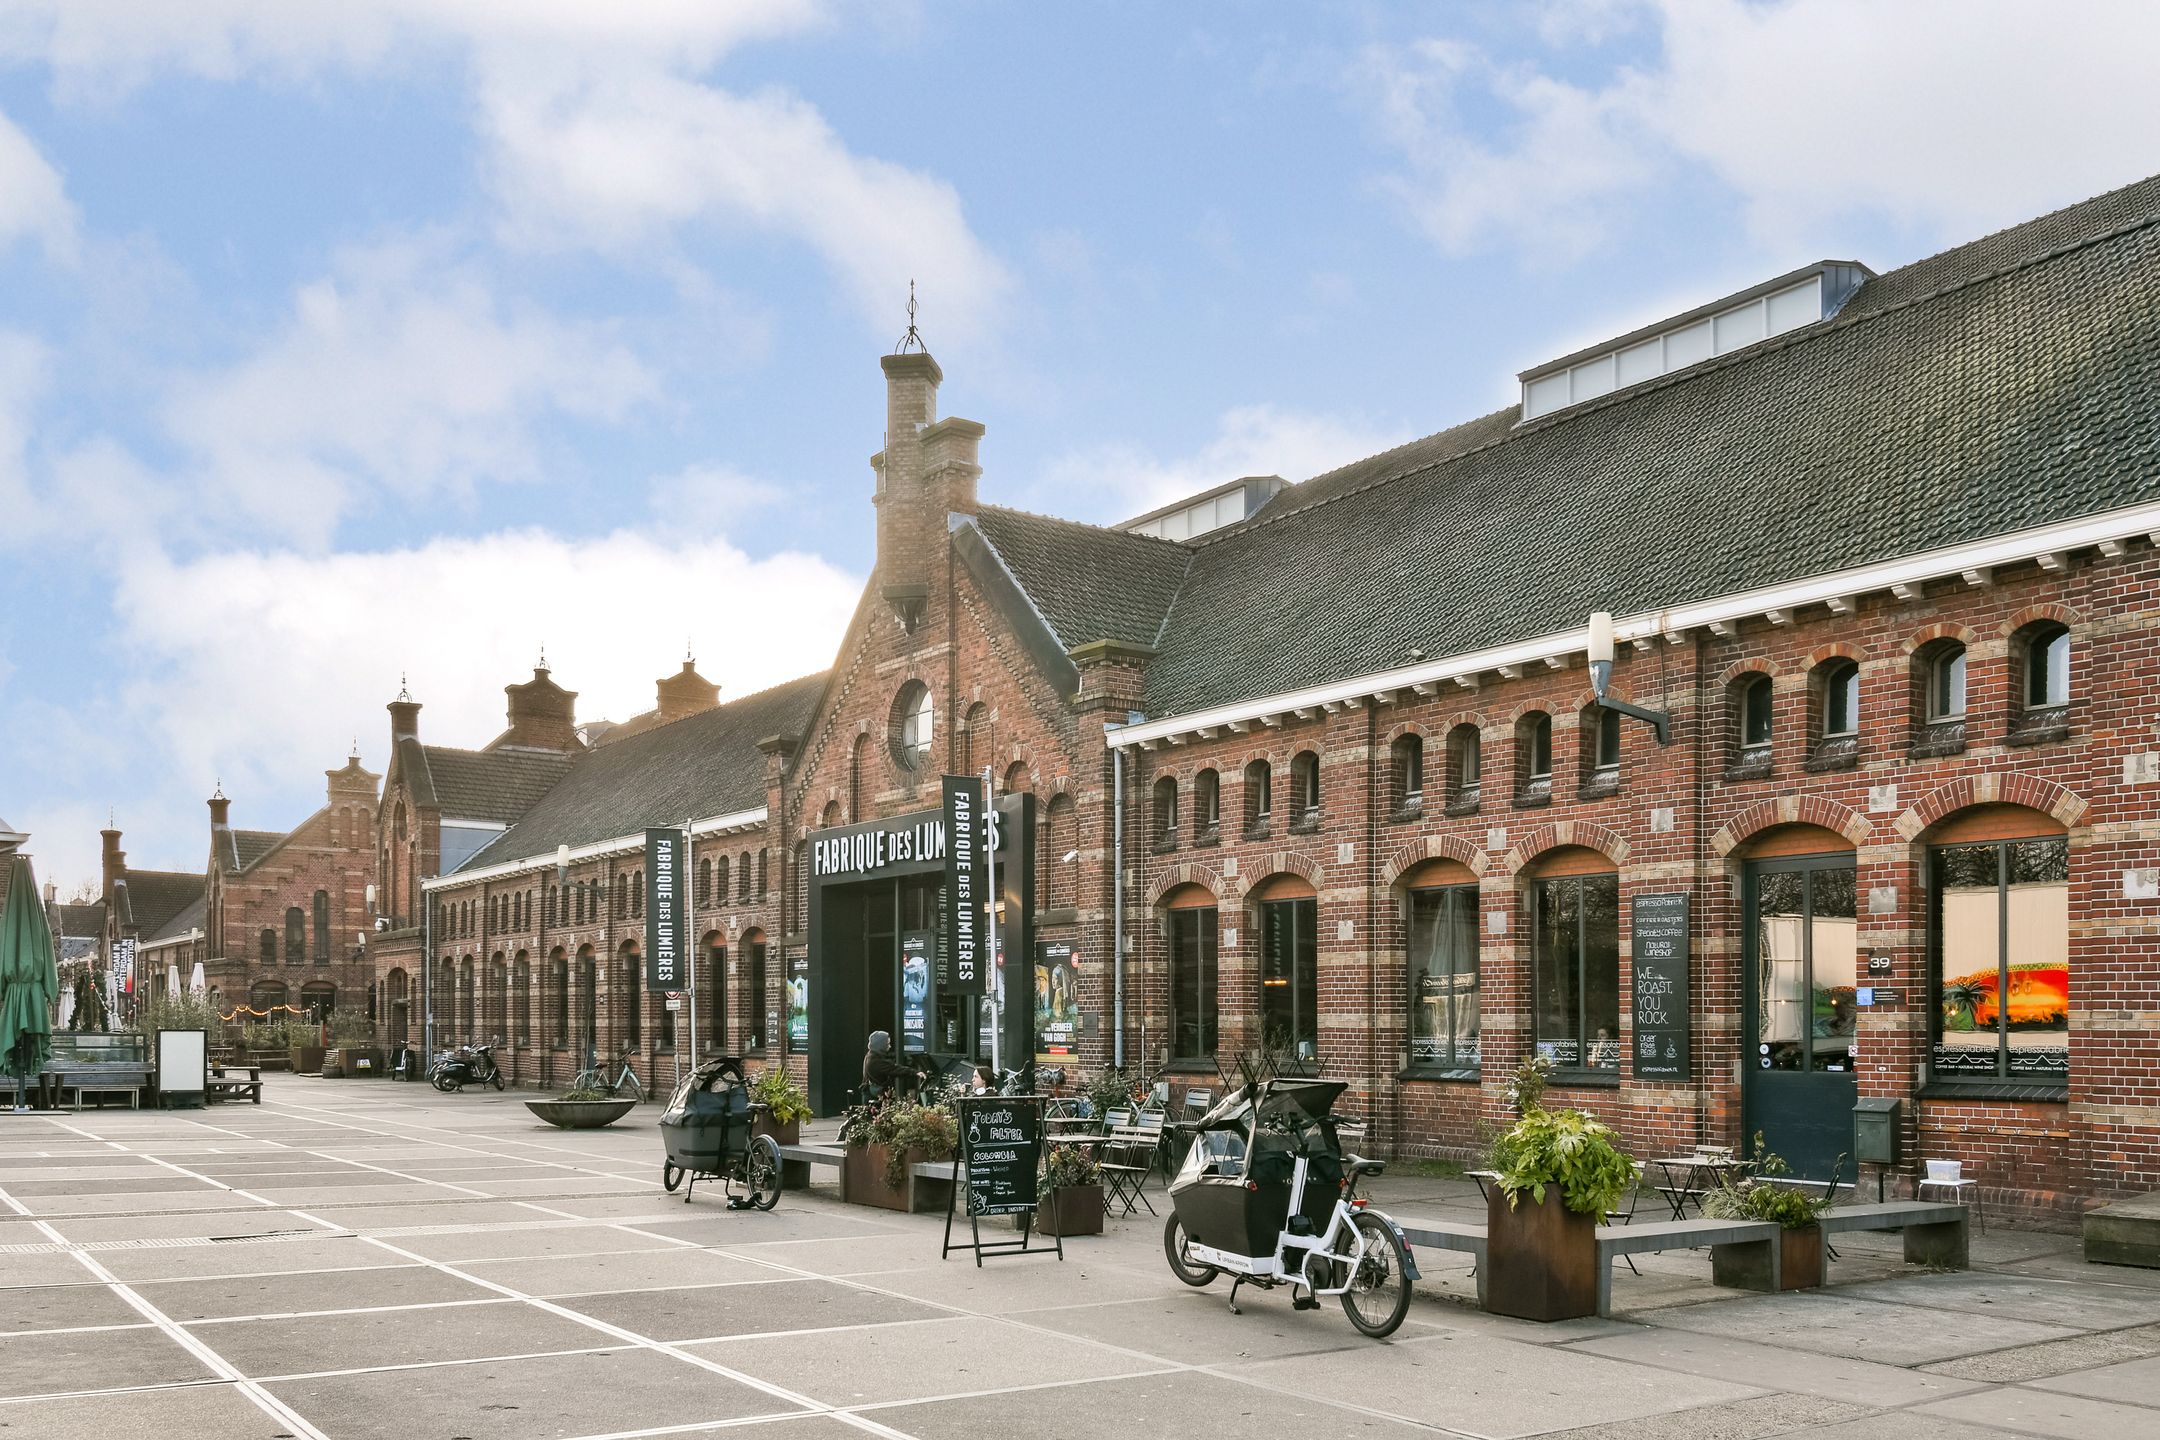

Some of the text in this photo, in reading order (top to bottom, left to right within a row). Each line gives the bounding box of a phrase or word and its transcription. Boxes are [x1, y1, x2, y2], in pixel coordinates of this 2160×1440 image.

[815, 830, 885, 875] FABRIQUE
[888, 830, 912, 862] DES
[655, 839, 673, 899] FABRIQUE
[954, 791, 976, 981] FABRIQUE DES LUMIÈRES
[659, 901, 671, 920] DES
[127, 939, 135, 964] MOTION
[658, 922, 676, 981] LUMIÈRES
[1870, 957, 1890, 968] 39
[119, 939, 128, 993] AMSTERDAM IN
[1637, 995, 1661, 1011] YOU
[1933, 1044, 1996, 1054] espressofabriek
[990, 1127, 1024, 1141] FILTER
[973, 1150, 1017, 1160] COLOMBIA
